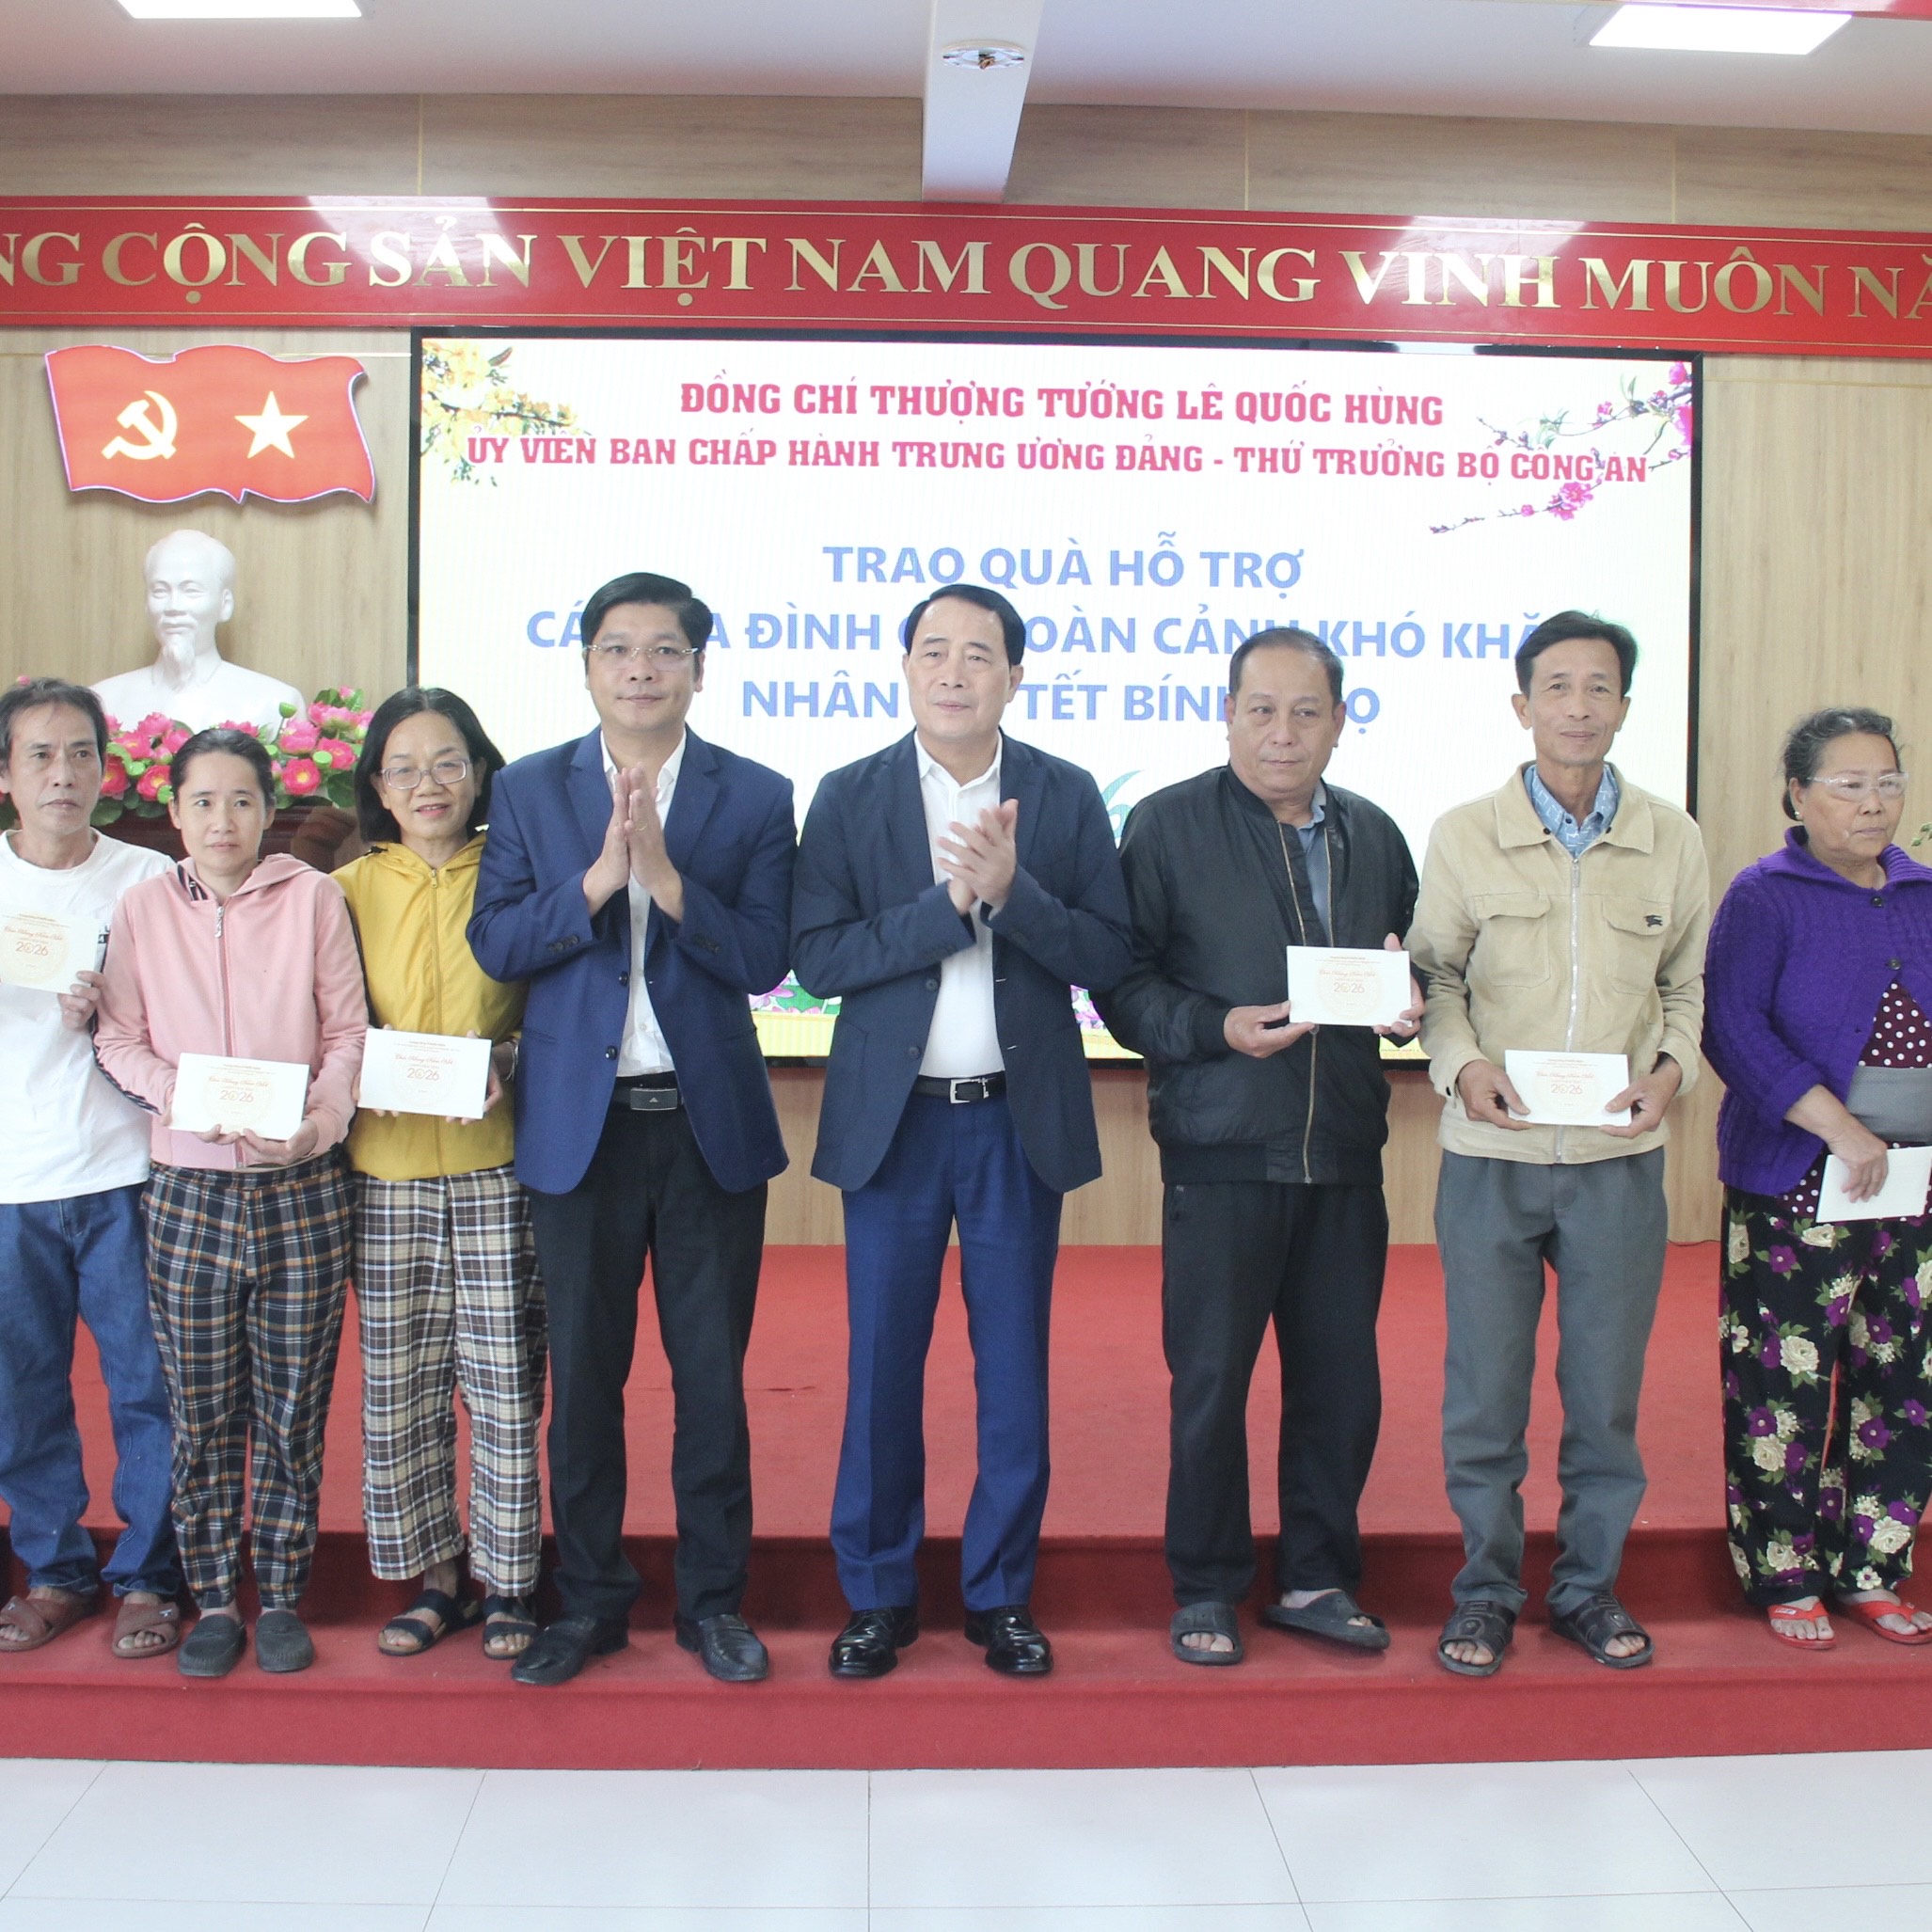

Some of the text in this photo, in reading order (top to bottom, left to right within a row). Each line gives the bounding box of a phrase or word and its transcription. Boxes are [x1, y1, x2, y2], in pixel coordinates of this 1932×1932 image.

[102, 220, 353, 304] CỘNG
[369, 215, 537, 288] SẢN
[557, 226, 767, 307] VIỆT
[784, 238, 992, 295] NAM
[1008, 241, 1321, 309] QUANG
[1338, 250, 1561, 308] VINH
[1579, 245, 1829, 317] MUÔN
[681, 369, 1443, 425] ĐỒNG CHÍ THƯỢNG TƯỚNG LÊ QUỐC HÙNG
[520, 430, 596, 464] VIÊN
[610, 438, 676, 465] BAN
[689, 427, 777, 466] CHẤP
[788, 433, 879, 467] HÀNH
[892, 441, 1005, 468] TRUNG
[1017, 436, 1104, 469] ƯƠNG
[1116, 434, 1202, 472] ĐẢNG
[1233, 438, 1305, 474] THỨ
[1312, 437, 1445, 478] TRƯỞNG
[1457, 445, 1499, 485] BỘ
[1511, 446, 1593, 482] CÔNG
[1605, 456, 1646, 483] AN
[822, 531, 1305, 600] TRAO QUÀ HỖ TRỢ
[527, 600, 583, 648] CÁ
[744, 602, 879, 650] ĐÌNH
[1024, 605, 1135, 653] OÀN
[1153, 603, 1299, 655] CẢN
[1319, 610, 1426, 658] KHÓ
[742, 669, 898, 718] NHÂN
[1017, 669, 1107, 721] TẾT
[15, 941, 49, 957] 2026
[1333, 981, 1365, 994] 2026
[219, 1089, 254, 1103] 2026
[406, 1068, 440, 1081] 2026
[1551, 1083, 1583, 1095] 2026
